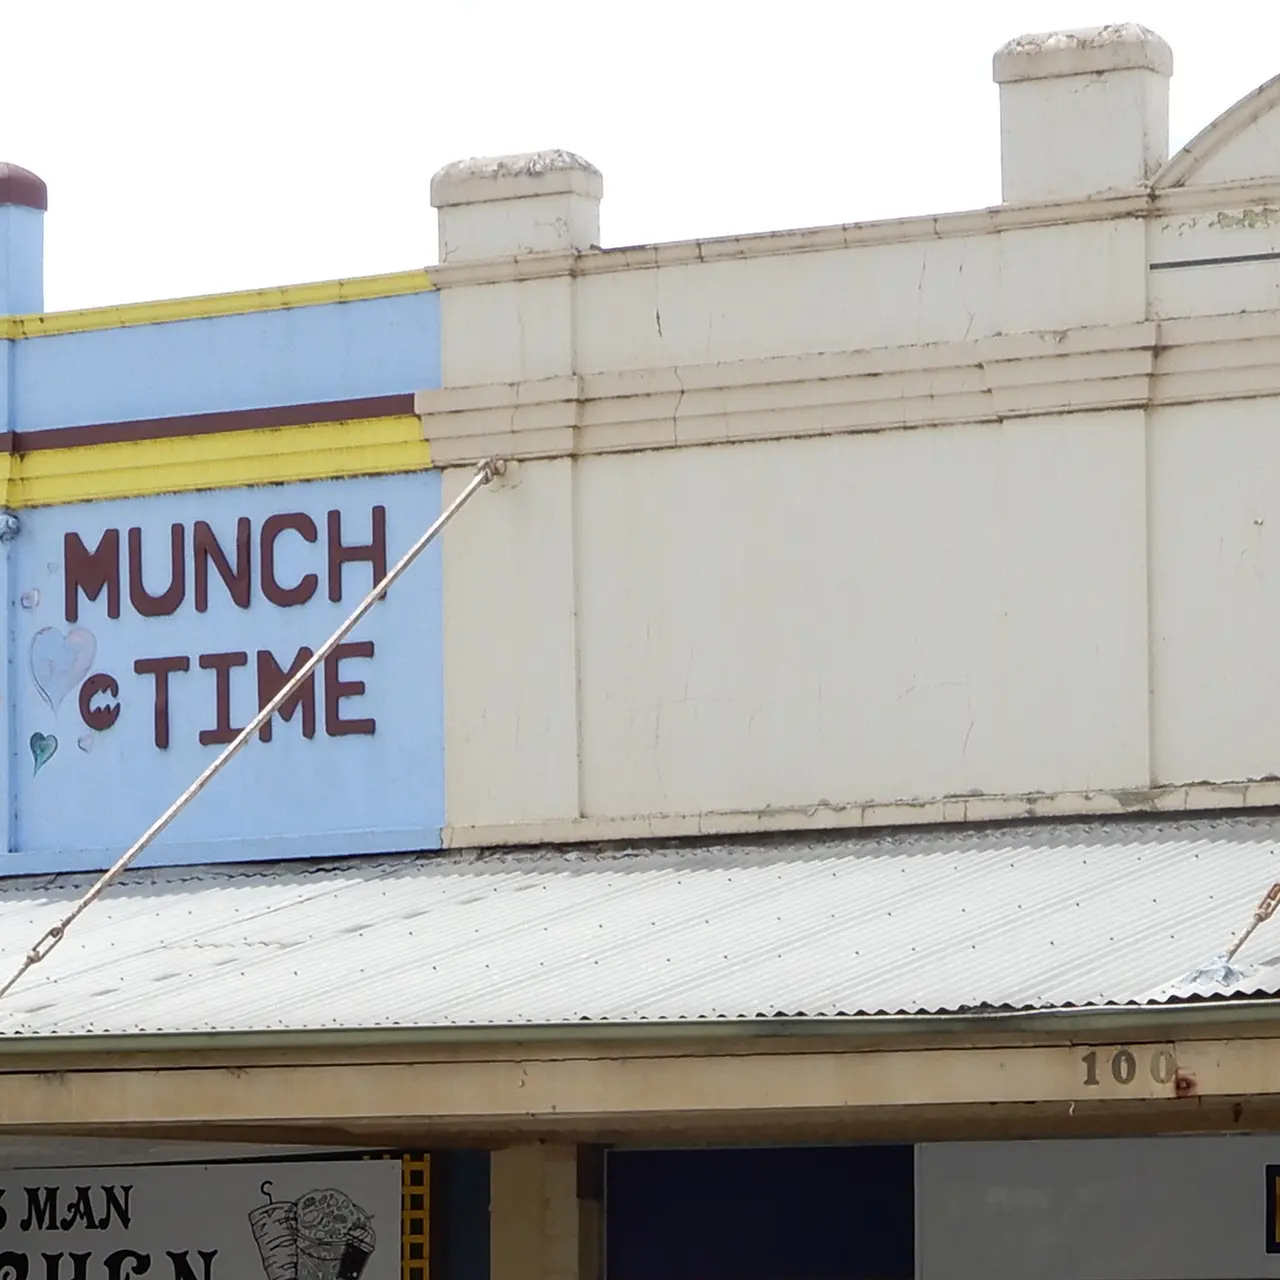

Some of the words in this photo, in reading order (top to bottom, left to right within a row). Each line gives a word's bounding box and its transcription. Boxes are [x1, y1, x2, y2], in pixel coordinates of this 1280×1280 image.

[63, 504, 388, 623] MUNCH
[133, 640, 377, 751] TIME
[20, 1184, 134, 1232] MAN
